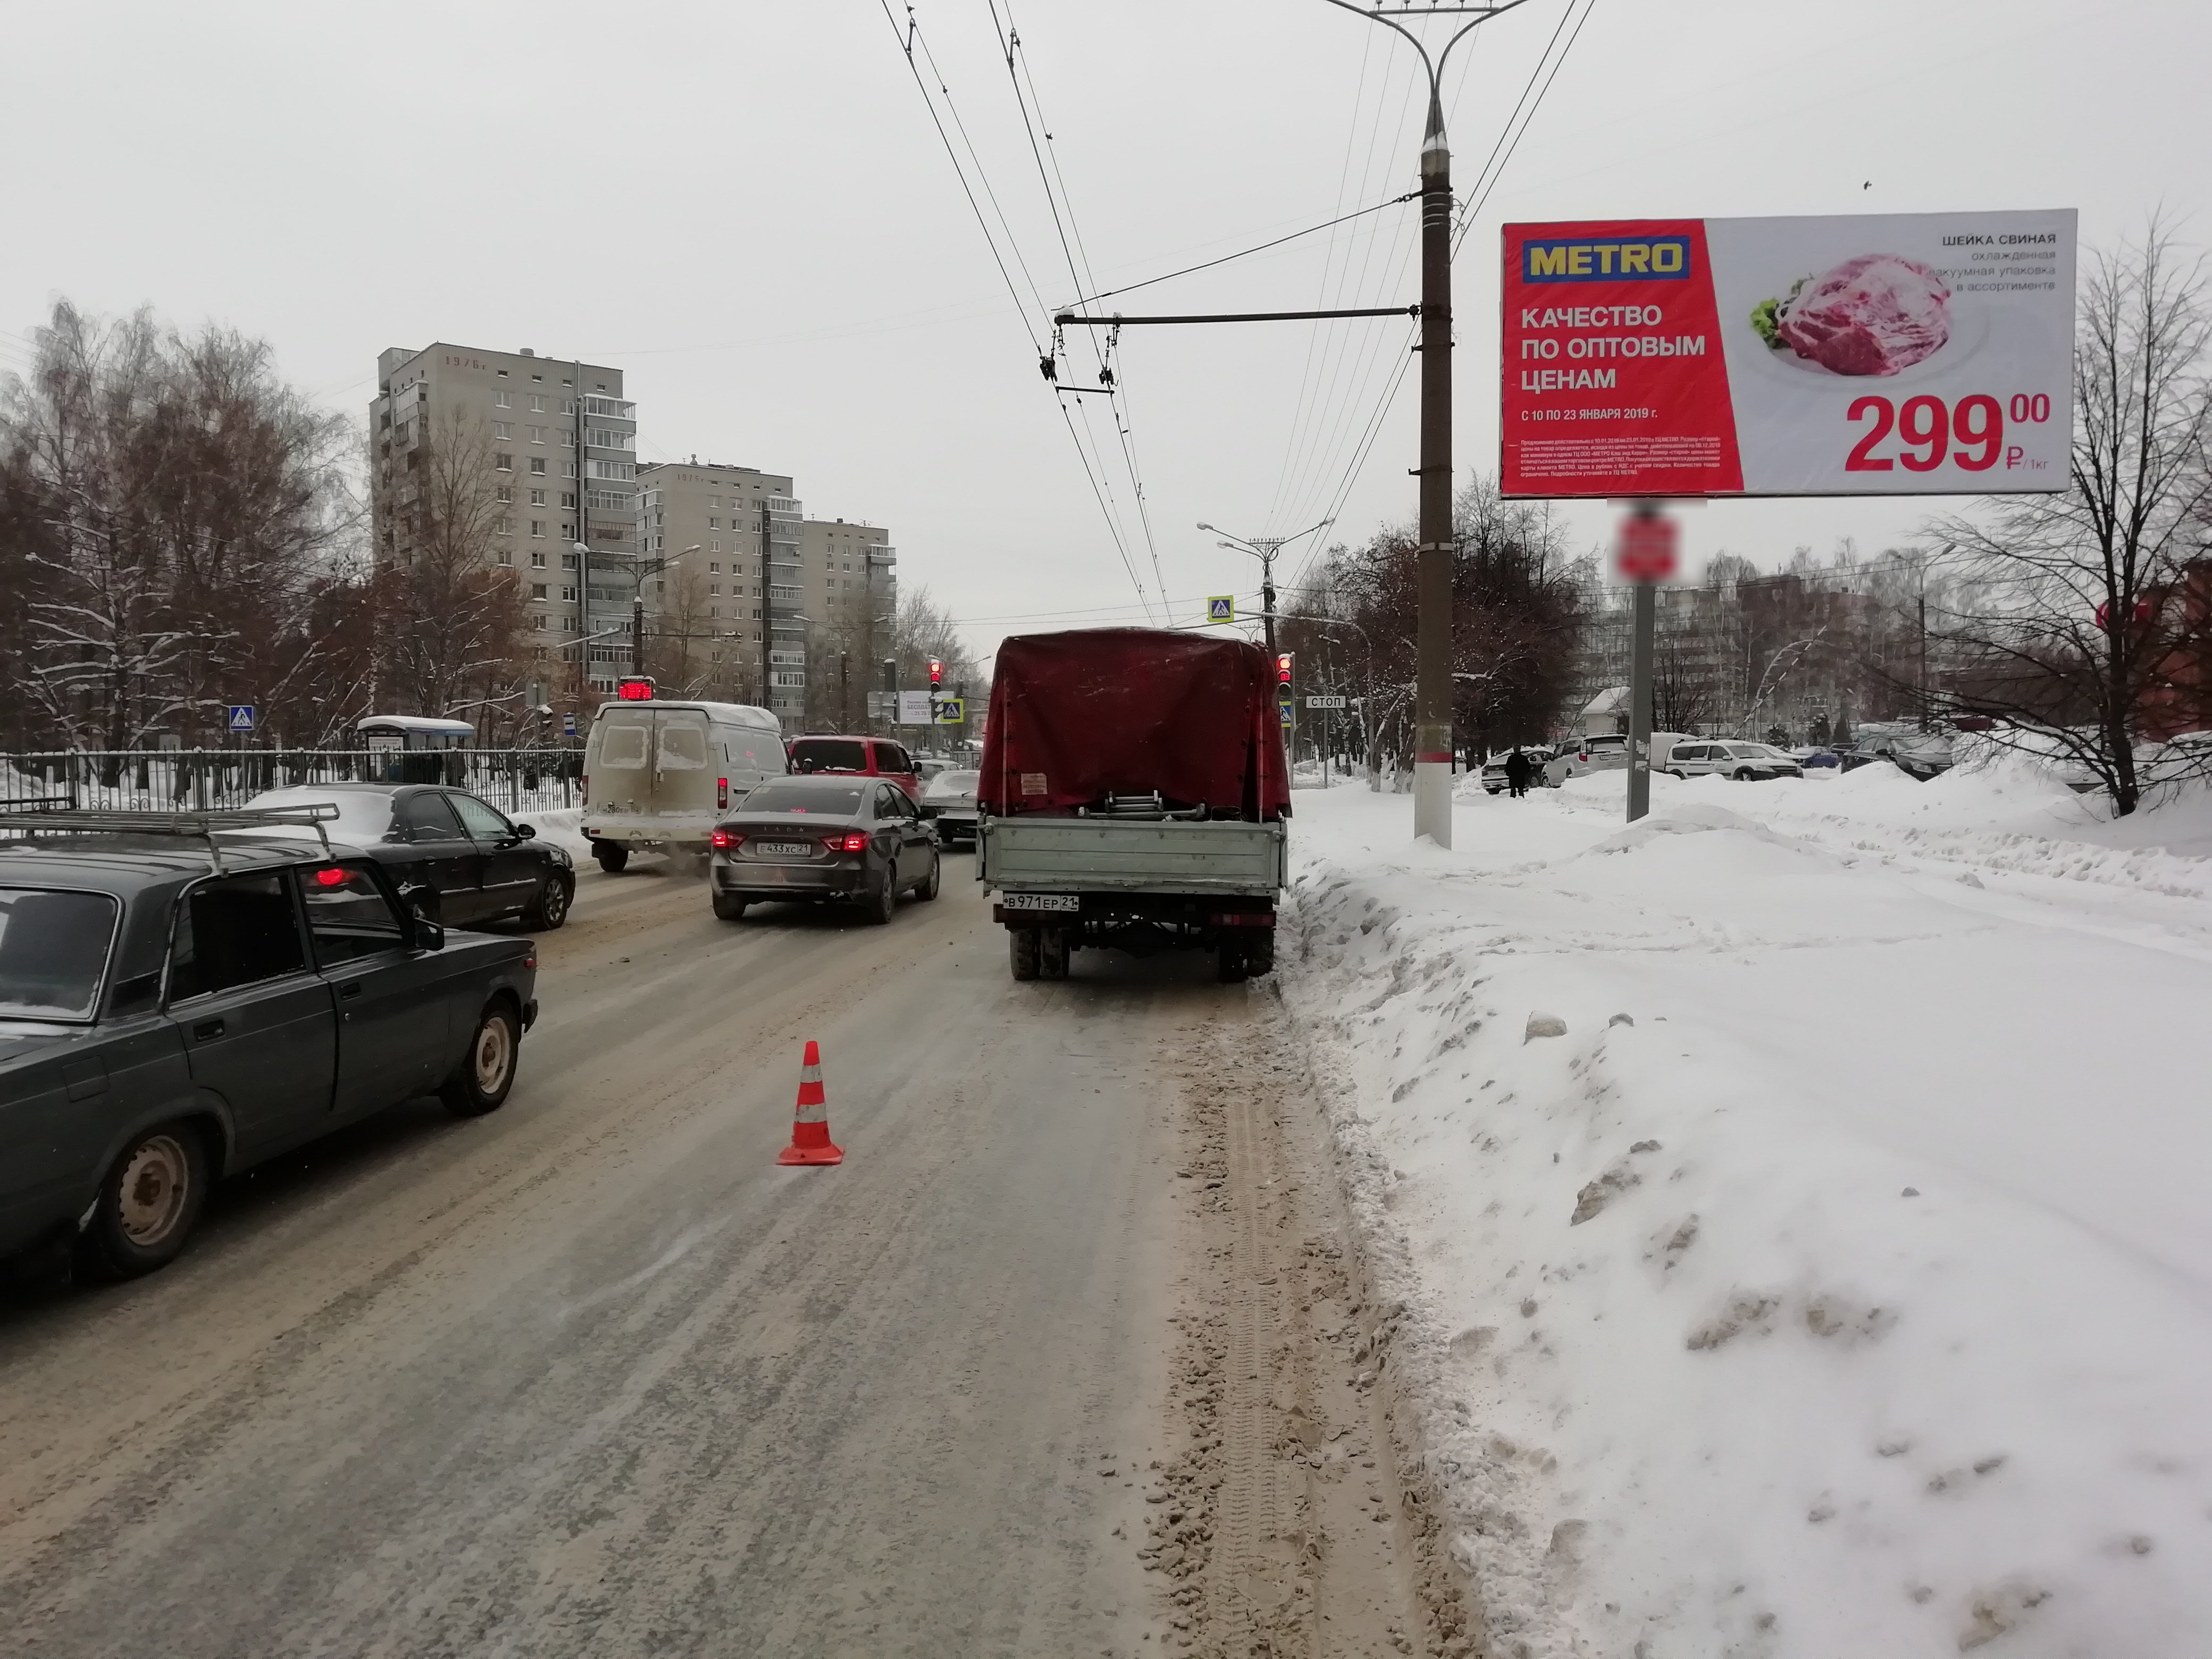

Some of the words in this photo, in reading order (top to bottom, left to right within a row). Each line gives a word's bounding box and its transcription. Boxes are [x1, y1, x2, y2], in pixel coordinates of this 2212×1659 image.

[1942, 233, 1994, 246] ШЕЙКА
[1999, 233, 2056, 245] СВИНАЯ
[1530, 243, 1682, 275] METRO
[1972, 251, 2056, 261] охлажденная
[1929, 266, 1995, 278] вакуумная
[1999, 266, 2056, 278] упаковка
[1967, 282, 2056, 292] ассортименте
[1522, 305, 1662, 329] КАЧЕСТВО
[1522, 339, 1559, 359] ПО
[1568, 336, 1705, 358] ОПТОВЫМ
[1522, 369, 1616, 395] ЦЕНАМ
[1521, 410, 1529, 421] С
[1532, 410, 1544, 421] 10
[1546, 409, 1561, 421] ПО
[1563, 409, 1577, 420] 23
[1579, 408, 1620, 420] ЯНВАРЯ
[1623, 408, 1648, 419] 2019
[1845, 394, 2004, 472] 299
[2010, 393, 2050, 423] 00
[1311, 698, 1340, 706] СТОП
